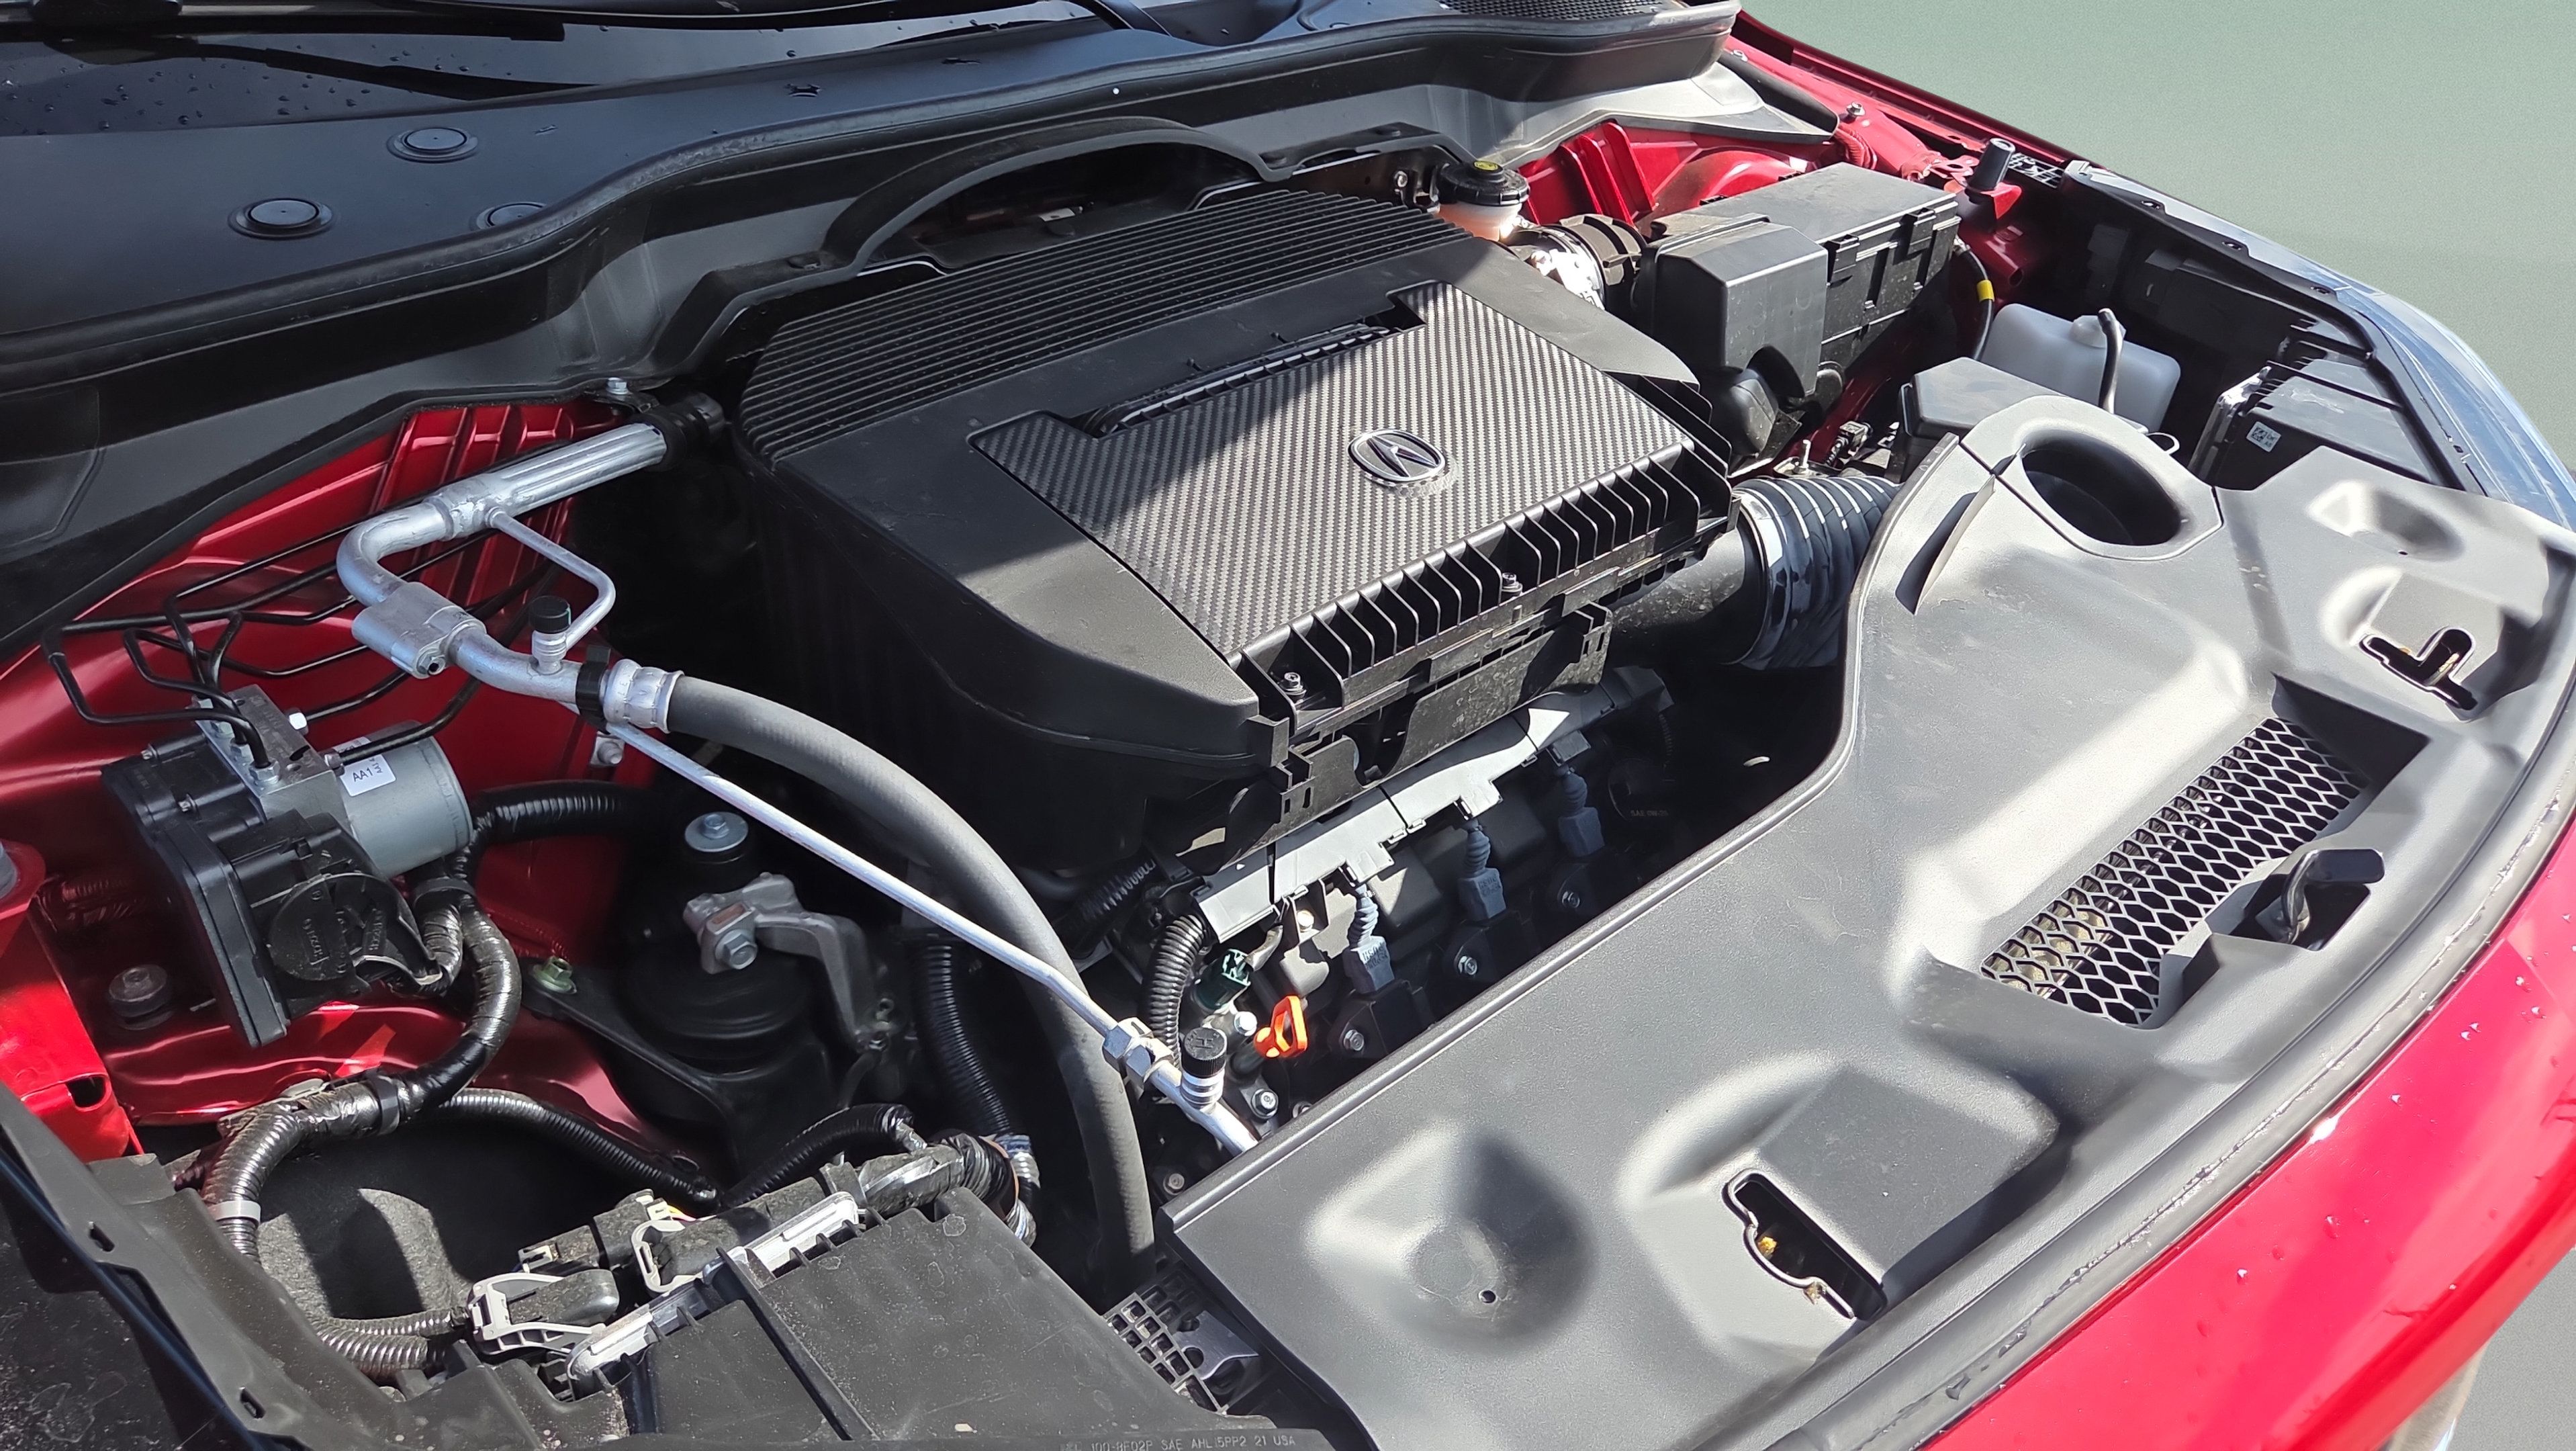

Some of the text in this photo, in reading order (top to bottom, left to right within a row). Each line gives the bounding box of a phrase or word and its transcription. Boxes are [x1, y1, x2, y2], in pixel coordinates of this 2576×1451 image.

[353, 766, 374, 783] AA1
[1161, 1438, 1183, 1451] SAE
[1254, 1435, 1267, 1446] 21
[1273, 1434, 1296, 1446] USA
